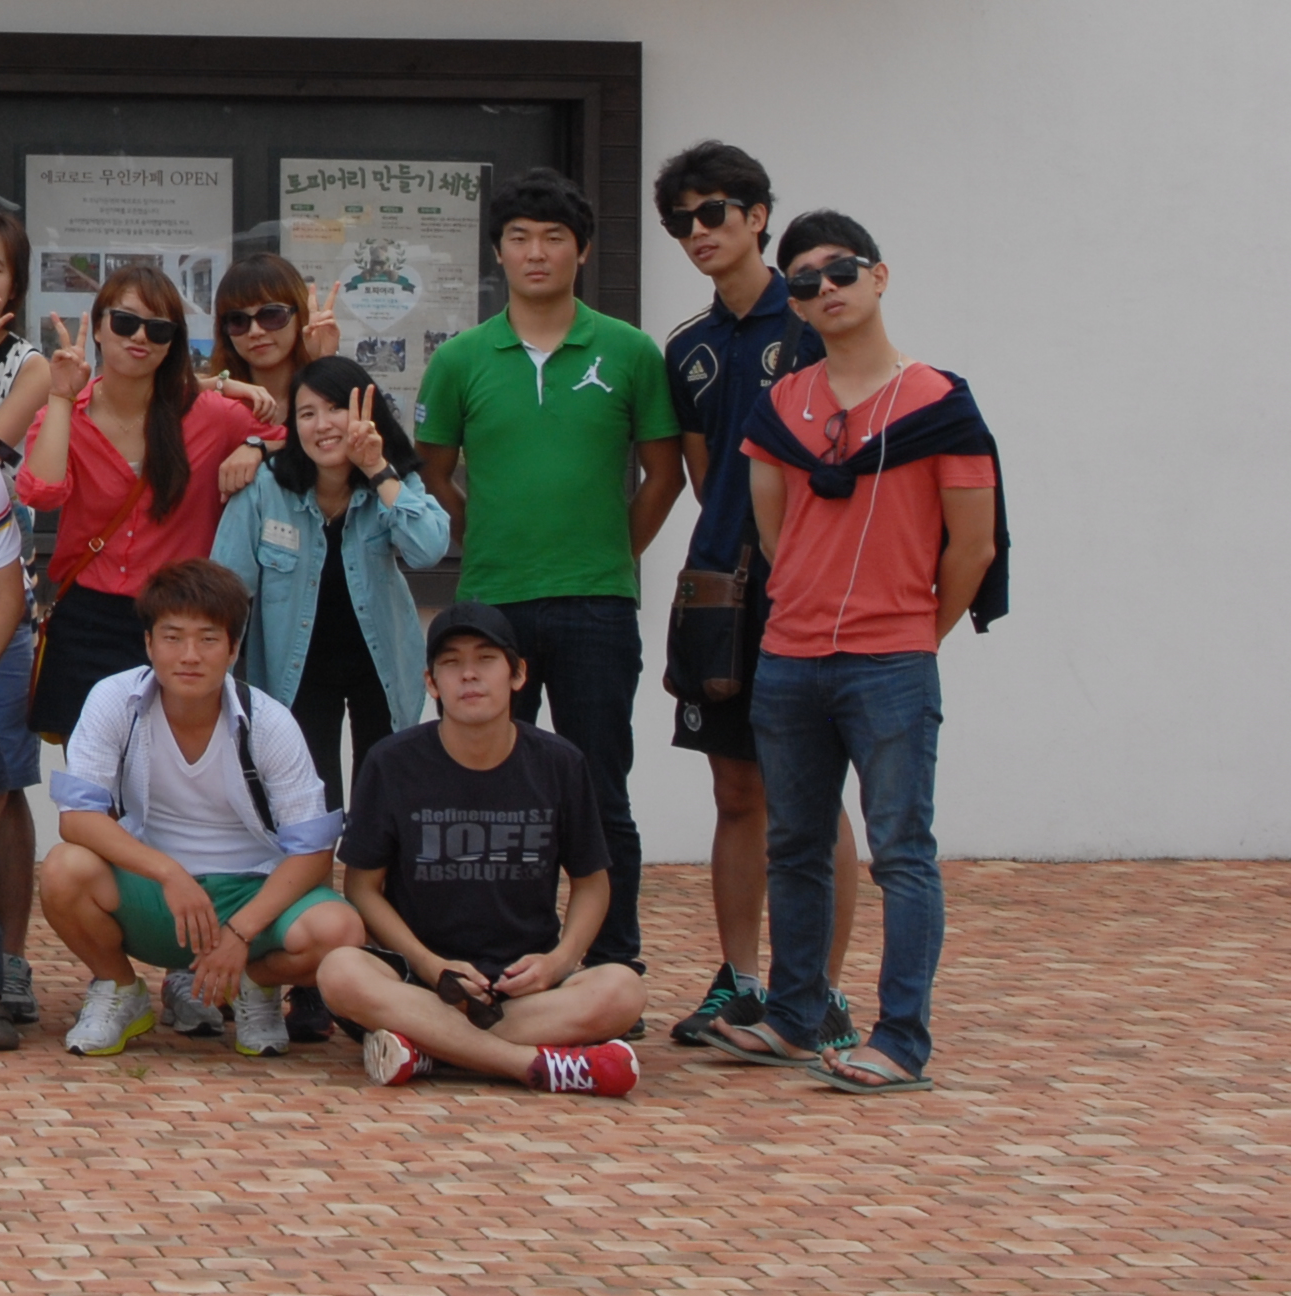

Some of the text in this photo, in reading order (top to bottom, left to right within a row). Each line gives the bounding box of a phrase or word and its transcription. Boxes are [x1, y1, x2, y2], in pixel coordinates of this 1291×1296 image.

[40, 169, 219, 187] 에코로드 무인카페 OPEN
[285, 164, 481, 201] 토피어리 만들기 체험
[421, 808, 526, 823] Refinement
[414, 862, 522, 882] ABSOLUTE
